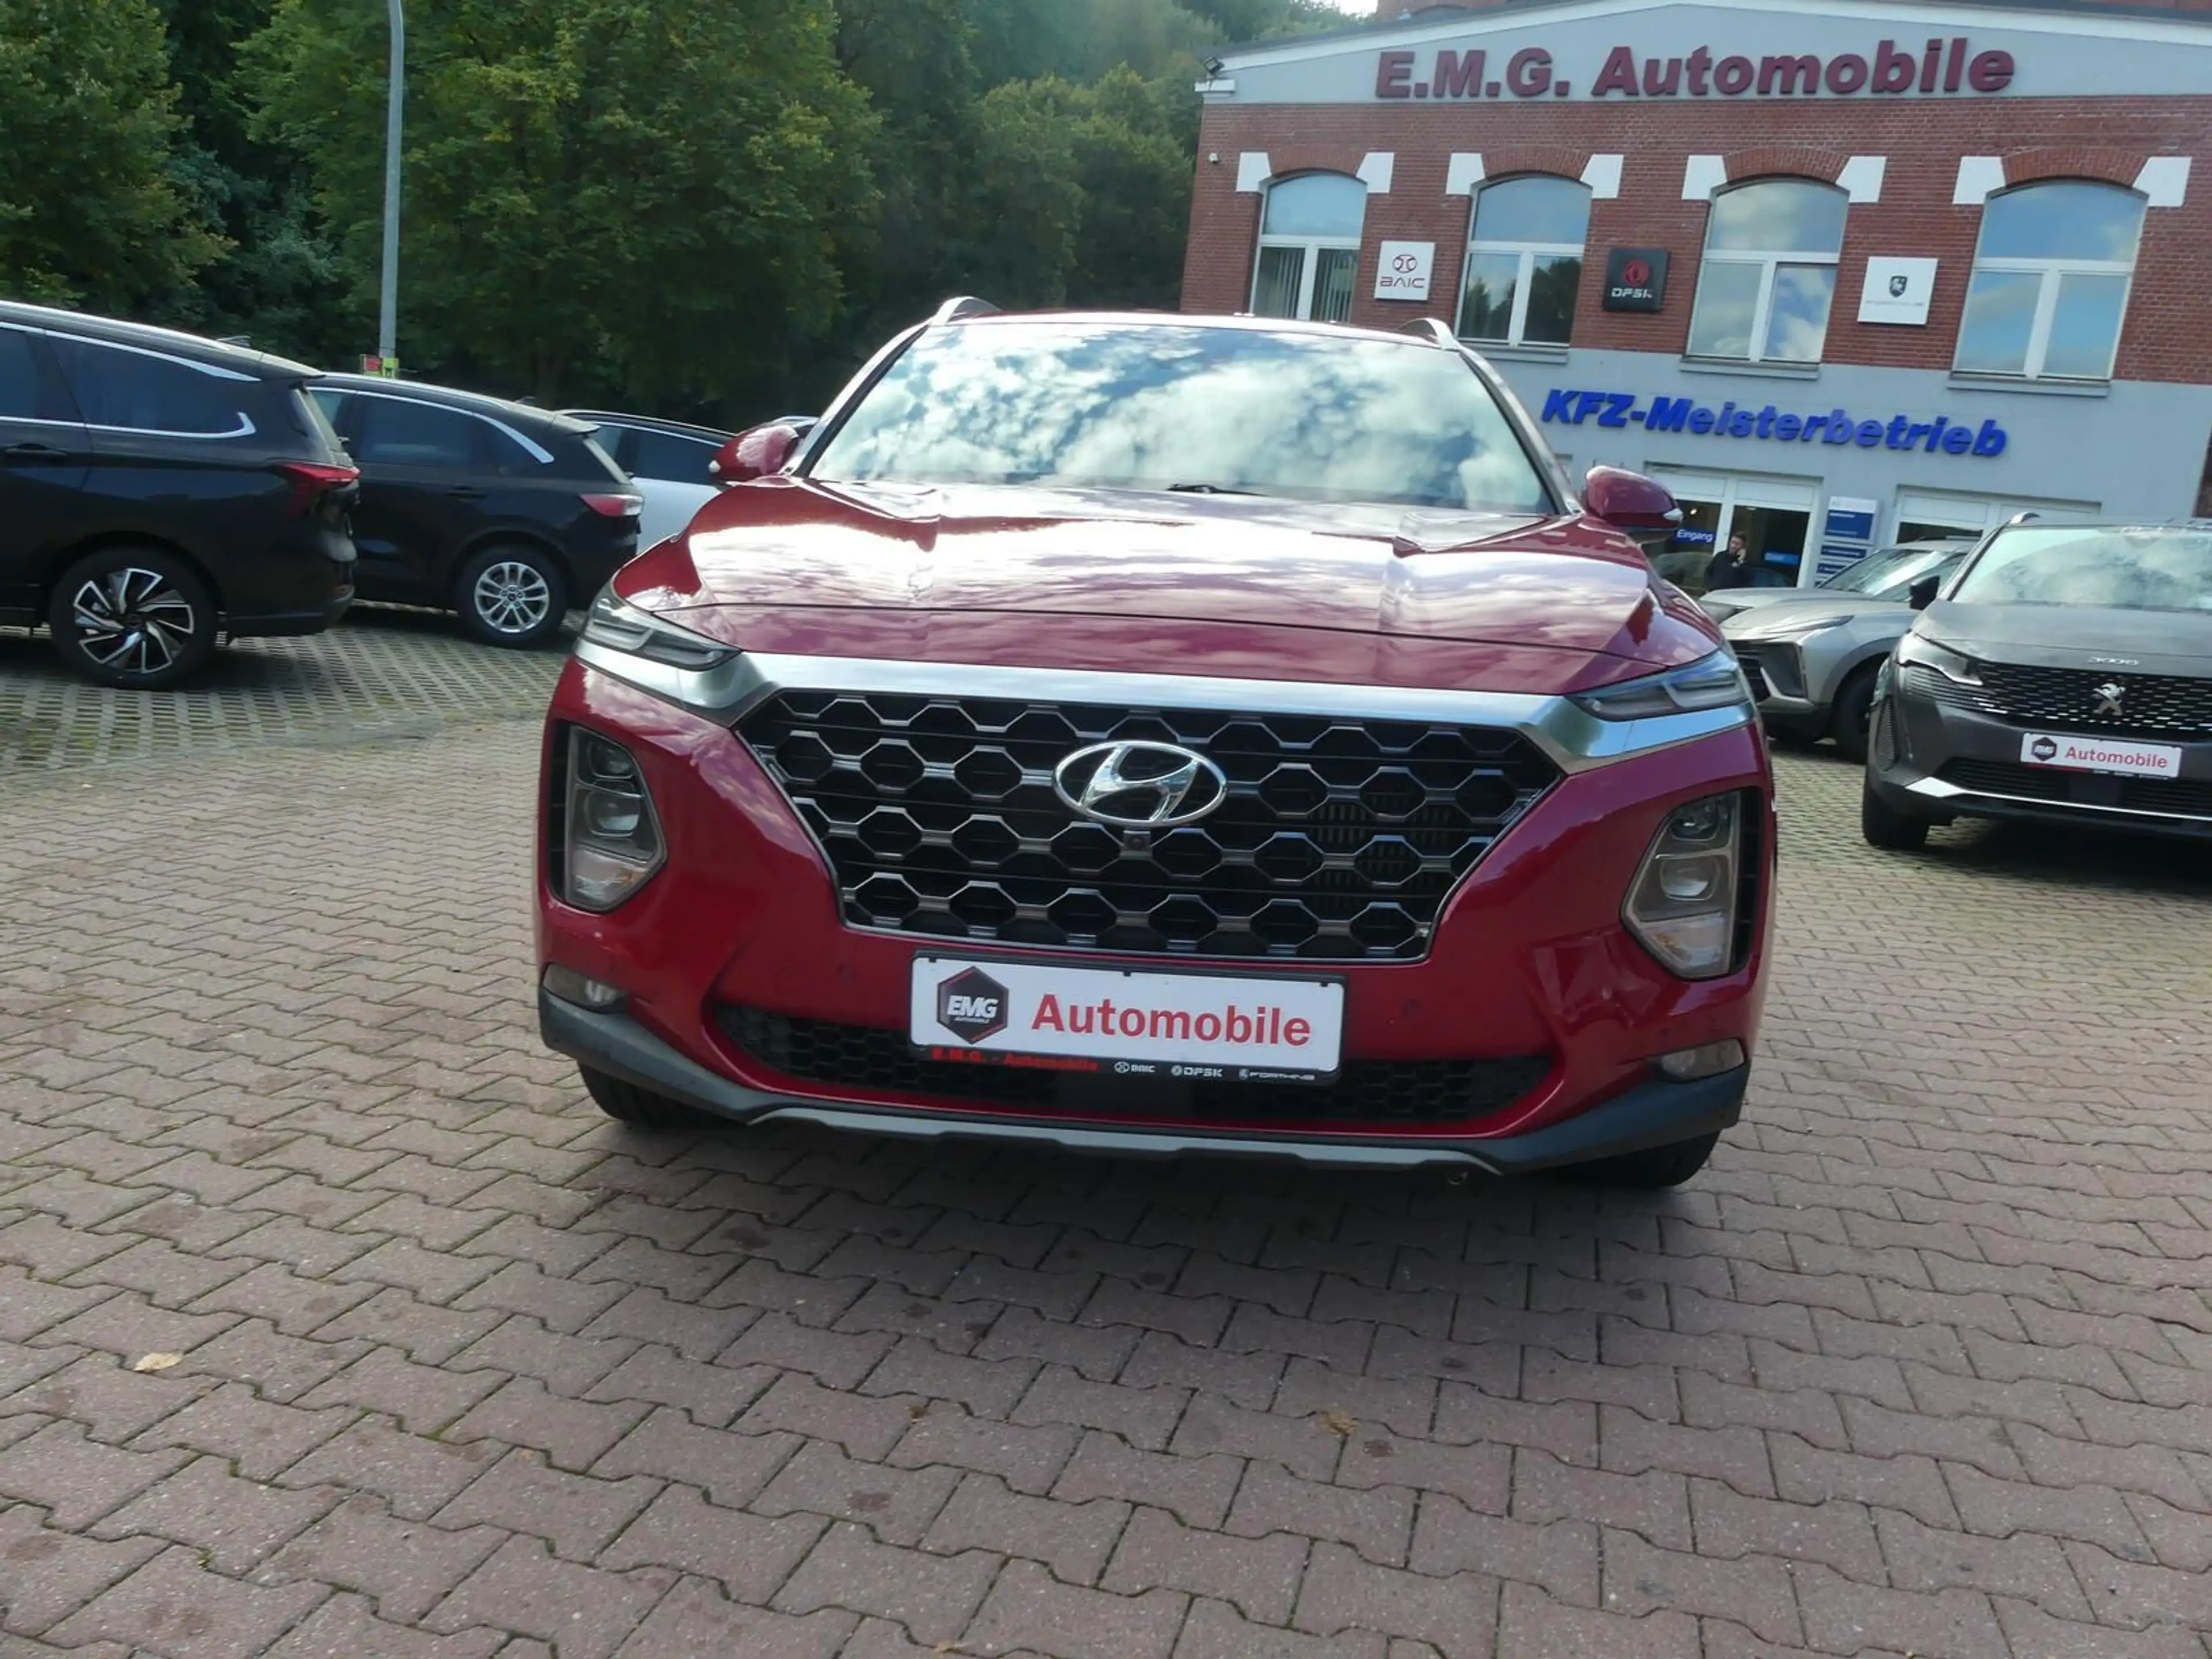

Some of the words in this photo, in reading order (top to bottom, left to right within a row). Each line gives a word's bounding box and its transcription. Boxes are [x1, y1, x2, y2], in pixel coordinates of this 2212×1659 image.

[1375, 47, 1570, 98] E.M.G.
[1591, 37, 2015, 97] Automobile
[1380, 276, 1425, 288] BAIC
[1541, 389, 2008, 457] KFZ-Meisterbetrieb
[1677, 529, 1713, 542] Eingang
[2065, 747, 2168, 768] Automobile
[946, 995, 999, 1018] EMG
[1031, 993, 1312, 1046] Automobile
[1183, 1067, 1223, 1078] DFSK
